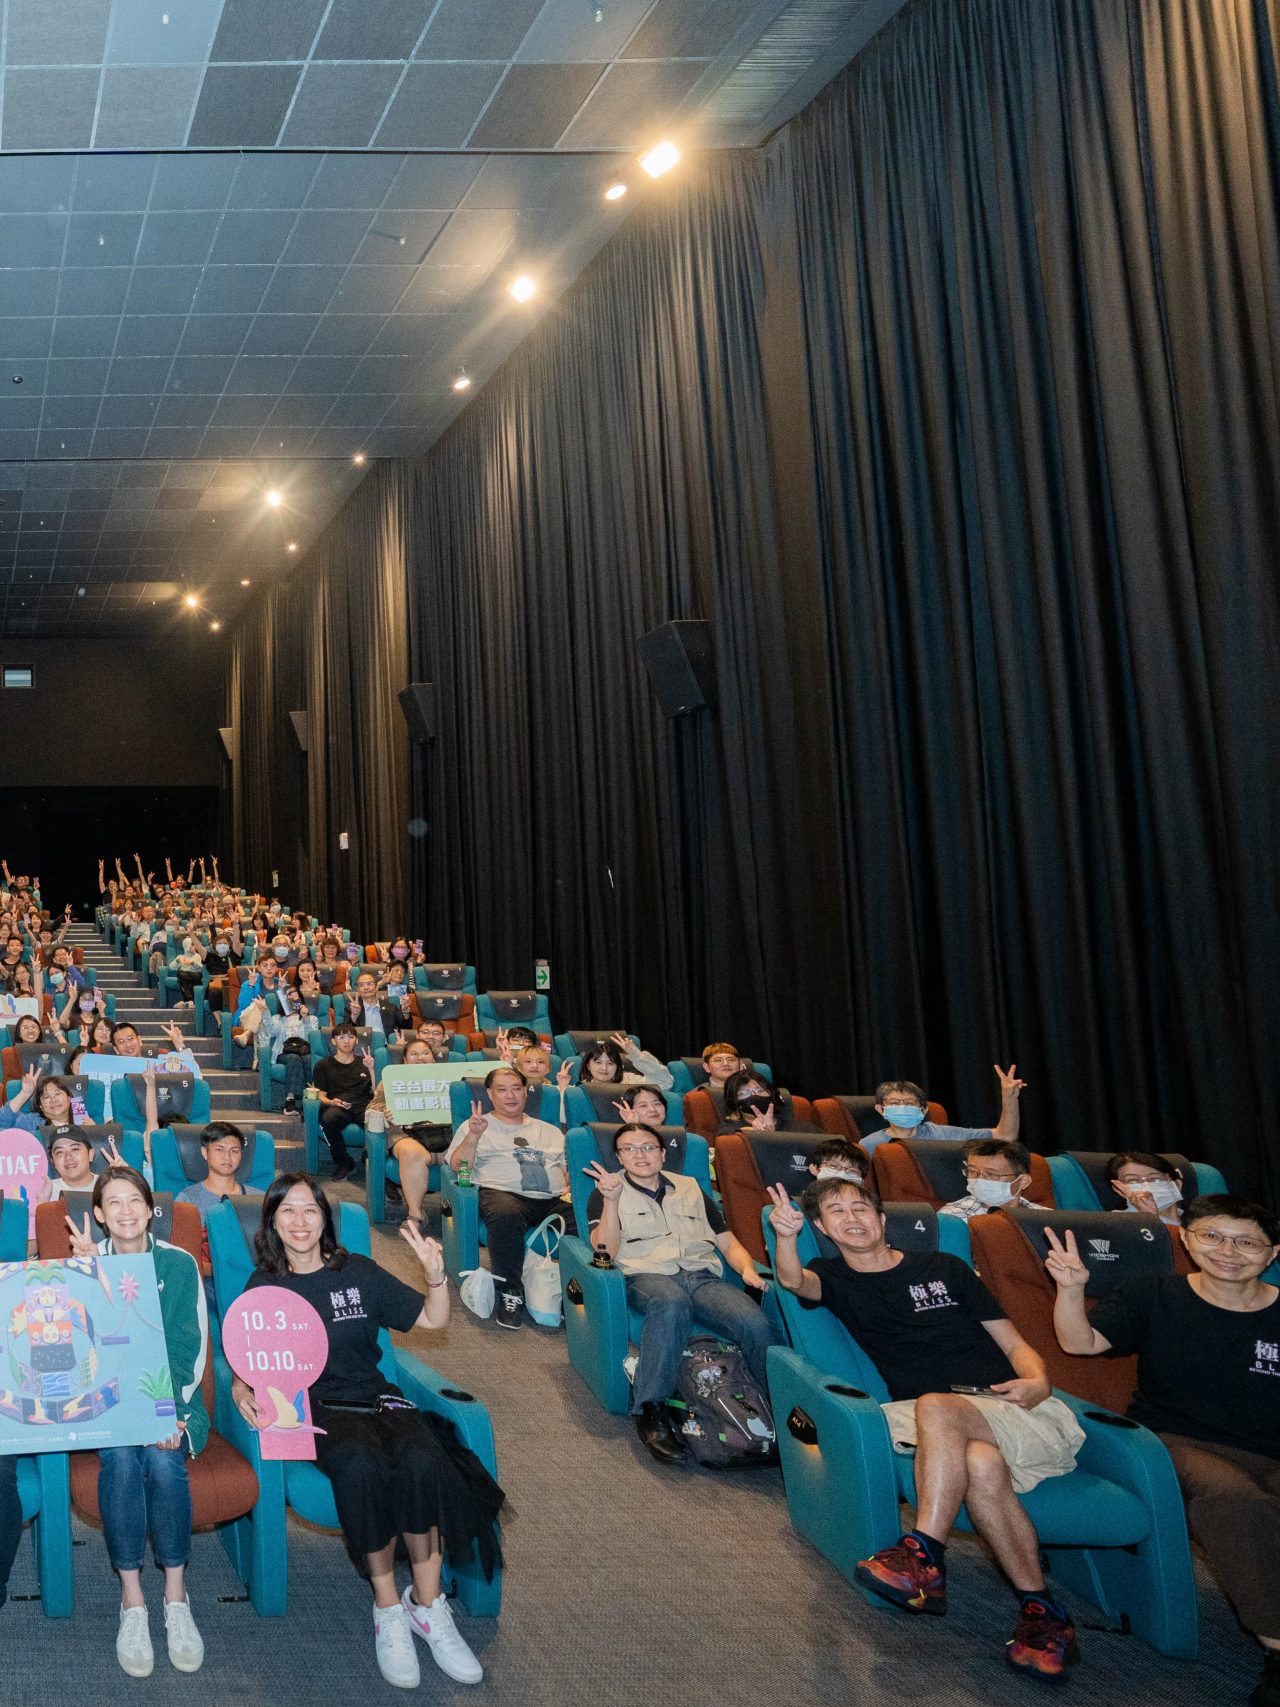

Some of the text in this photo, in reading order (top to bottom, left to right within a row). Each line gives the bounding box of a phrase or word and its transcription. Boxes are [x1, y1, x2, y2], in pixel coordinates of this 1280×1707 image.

[392, 1079, 450, 1093] 全台最大
[108, 1135, 114, 1144] 6
[670, 1139, 677, 1147] 4
[153, 1206, 162, 1217] 6
[915, 1220, 925, 1232] 4
[1140, 1228, 1154, 1241] 3
[909, 1280, 948, 1301] 極樂
[330, 1287, 361, 1309] 極樂
[915, 1296, 951, 1308] BLISS
[334, 1307, 364, 1318] BLISS
[246, 1350, 295, 1371] 10.10
